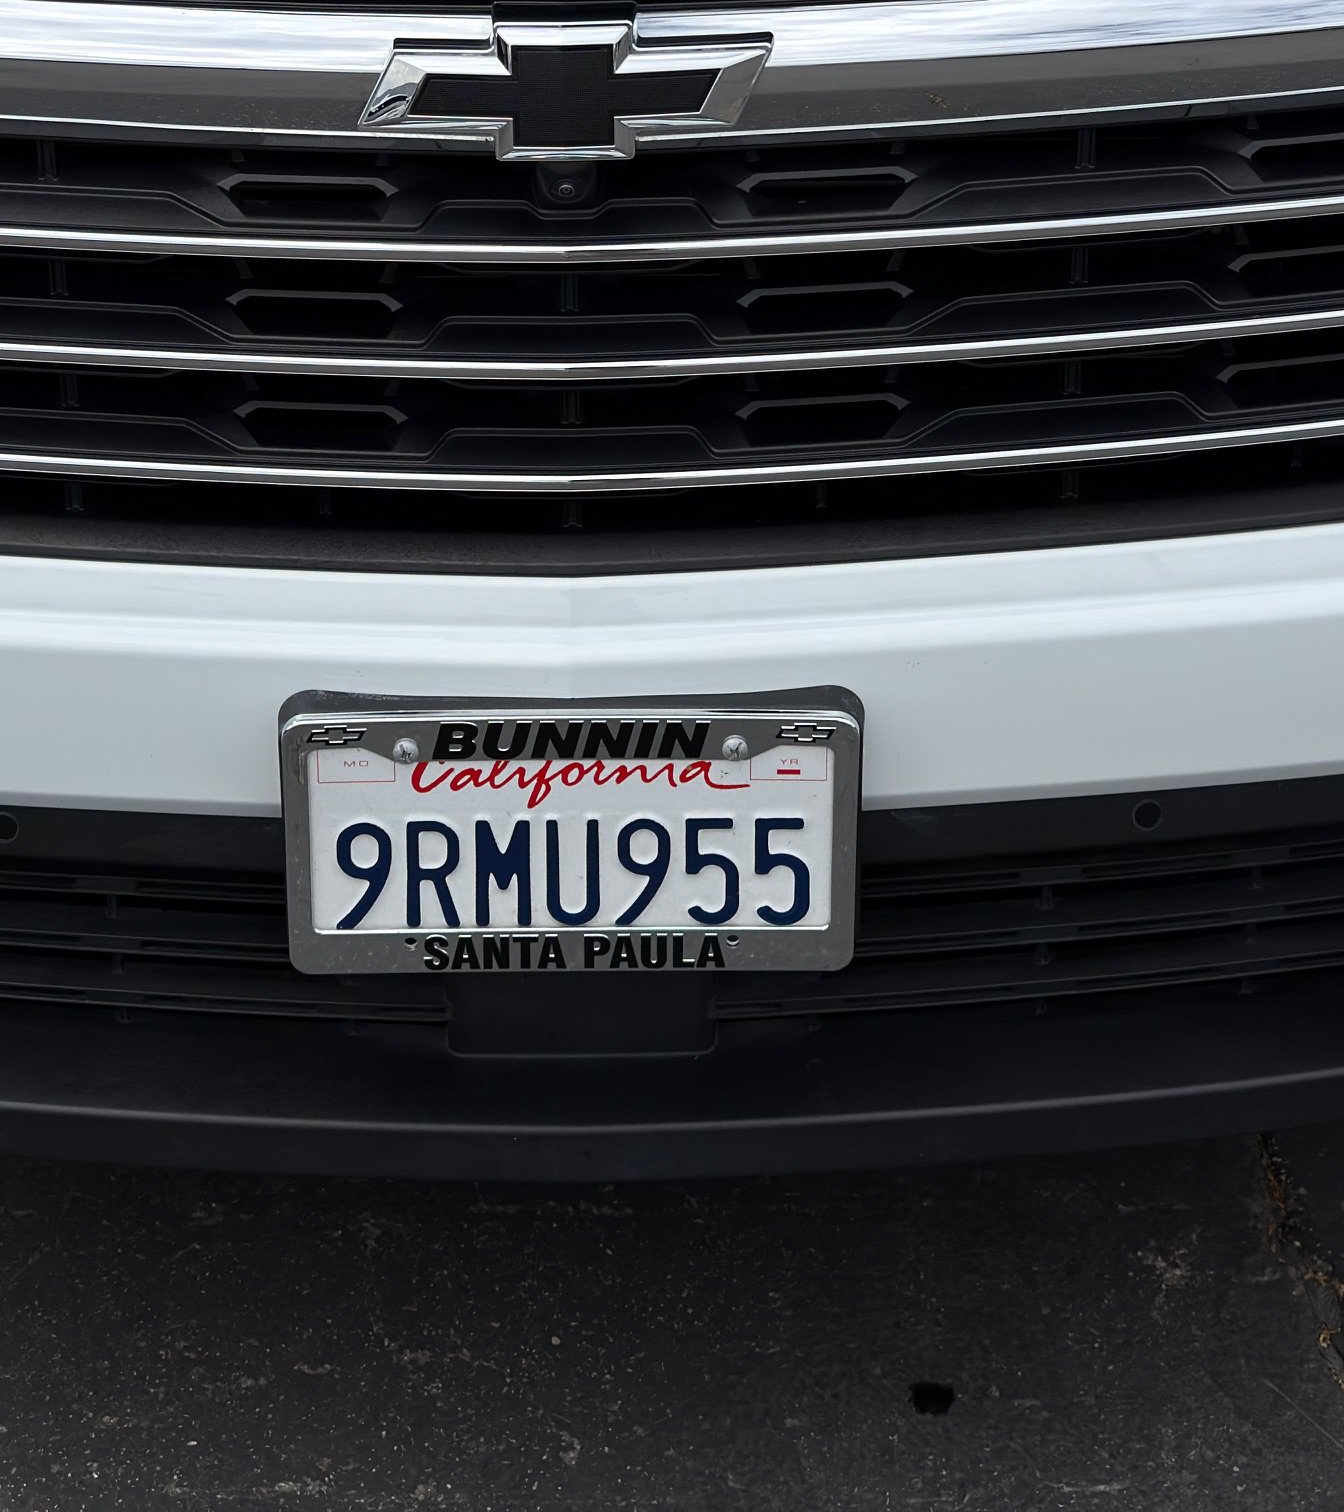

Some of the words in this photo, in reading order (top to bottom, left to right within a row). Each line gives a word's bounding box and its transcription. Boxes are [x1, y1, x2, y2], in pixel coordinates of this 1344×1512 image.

[432, 720, 711, 760] BUNNIN
[343, 759, 369, 768] MO
[780, 758, 799, 766] YR
[411, 759, 751, 809] California
[336, 817, 811, 930] 9RMU955
[423, 933, 567, 970] SANTA
[583, 932, 726, 969] PAULA
